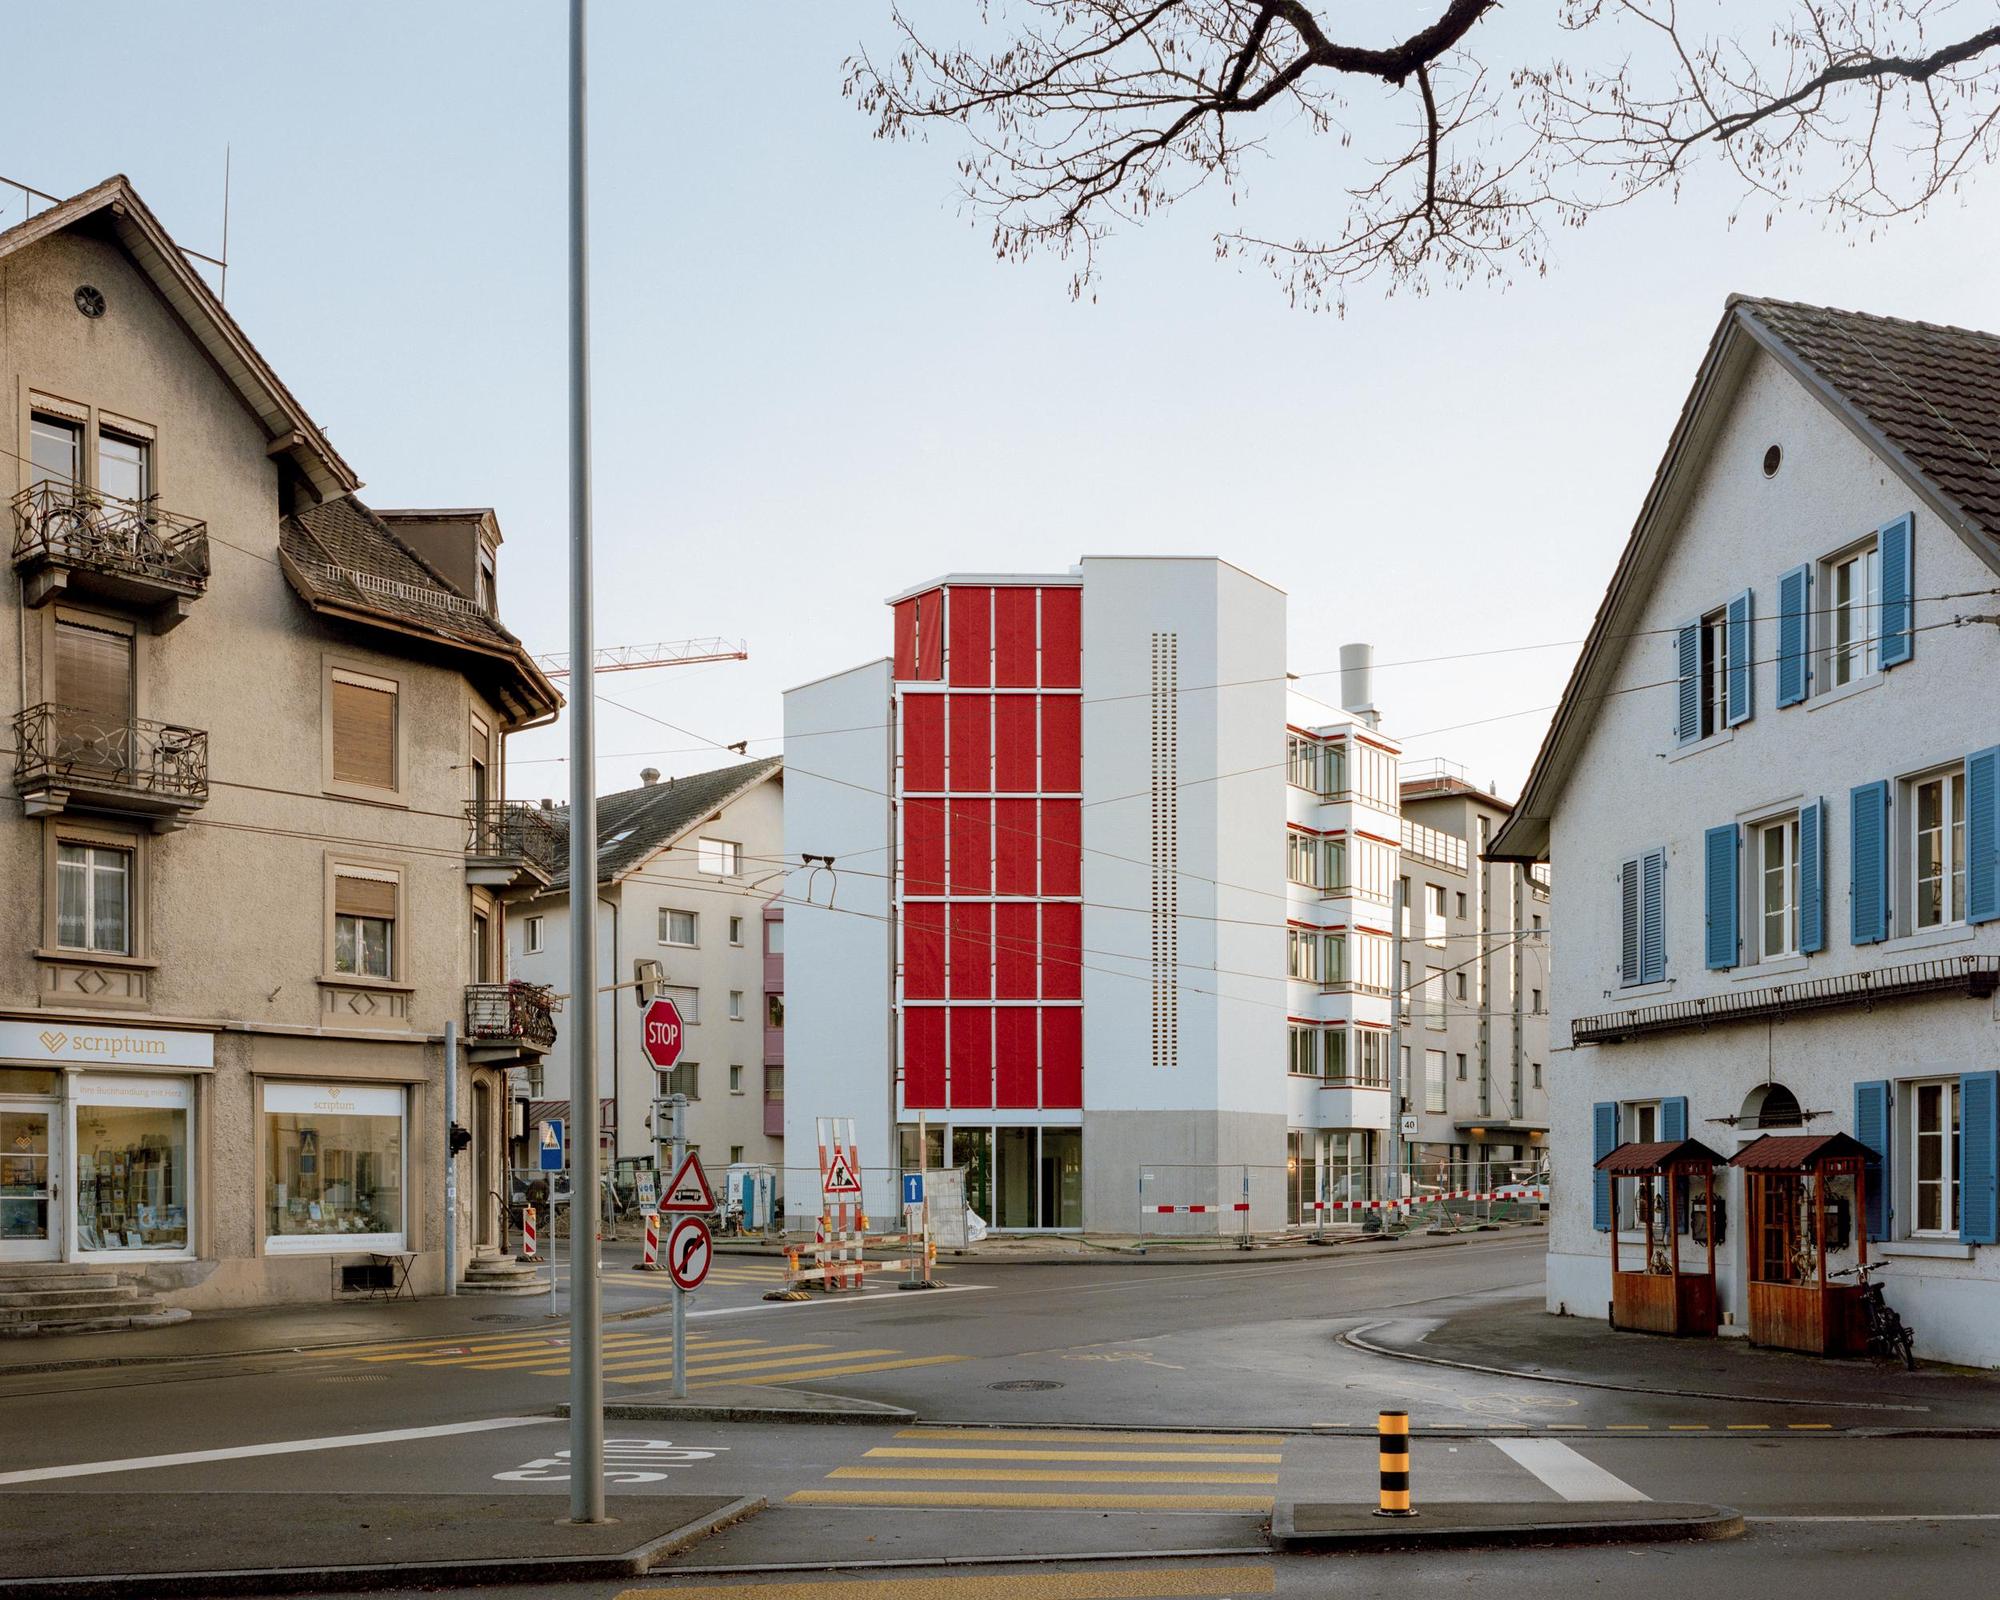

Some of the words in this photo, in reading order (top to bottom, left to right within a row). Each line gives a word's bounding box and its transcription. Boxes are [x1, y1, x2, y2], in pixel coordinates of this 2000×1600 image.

[648, 1021, 679, 1046] STOP
[72, 1035, 167, 1058] scriptum
[313, 1101, 355, 1113] scriptum
[1404, 1121, 1415, 1129] 40
[492, 1439, 731, 1483] STOP
